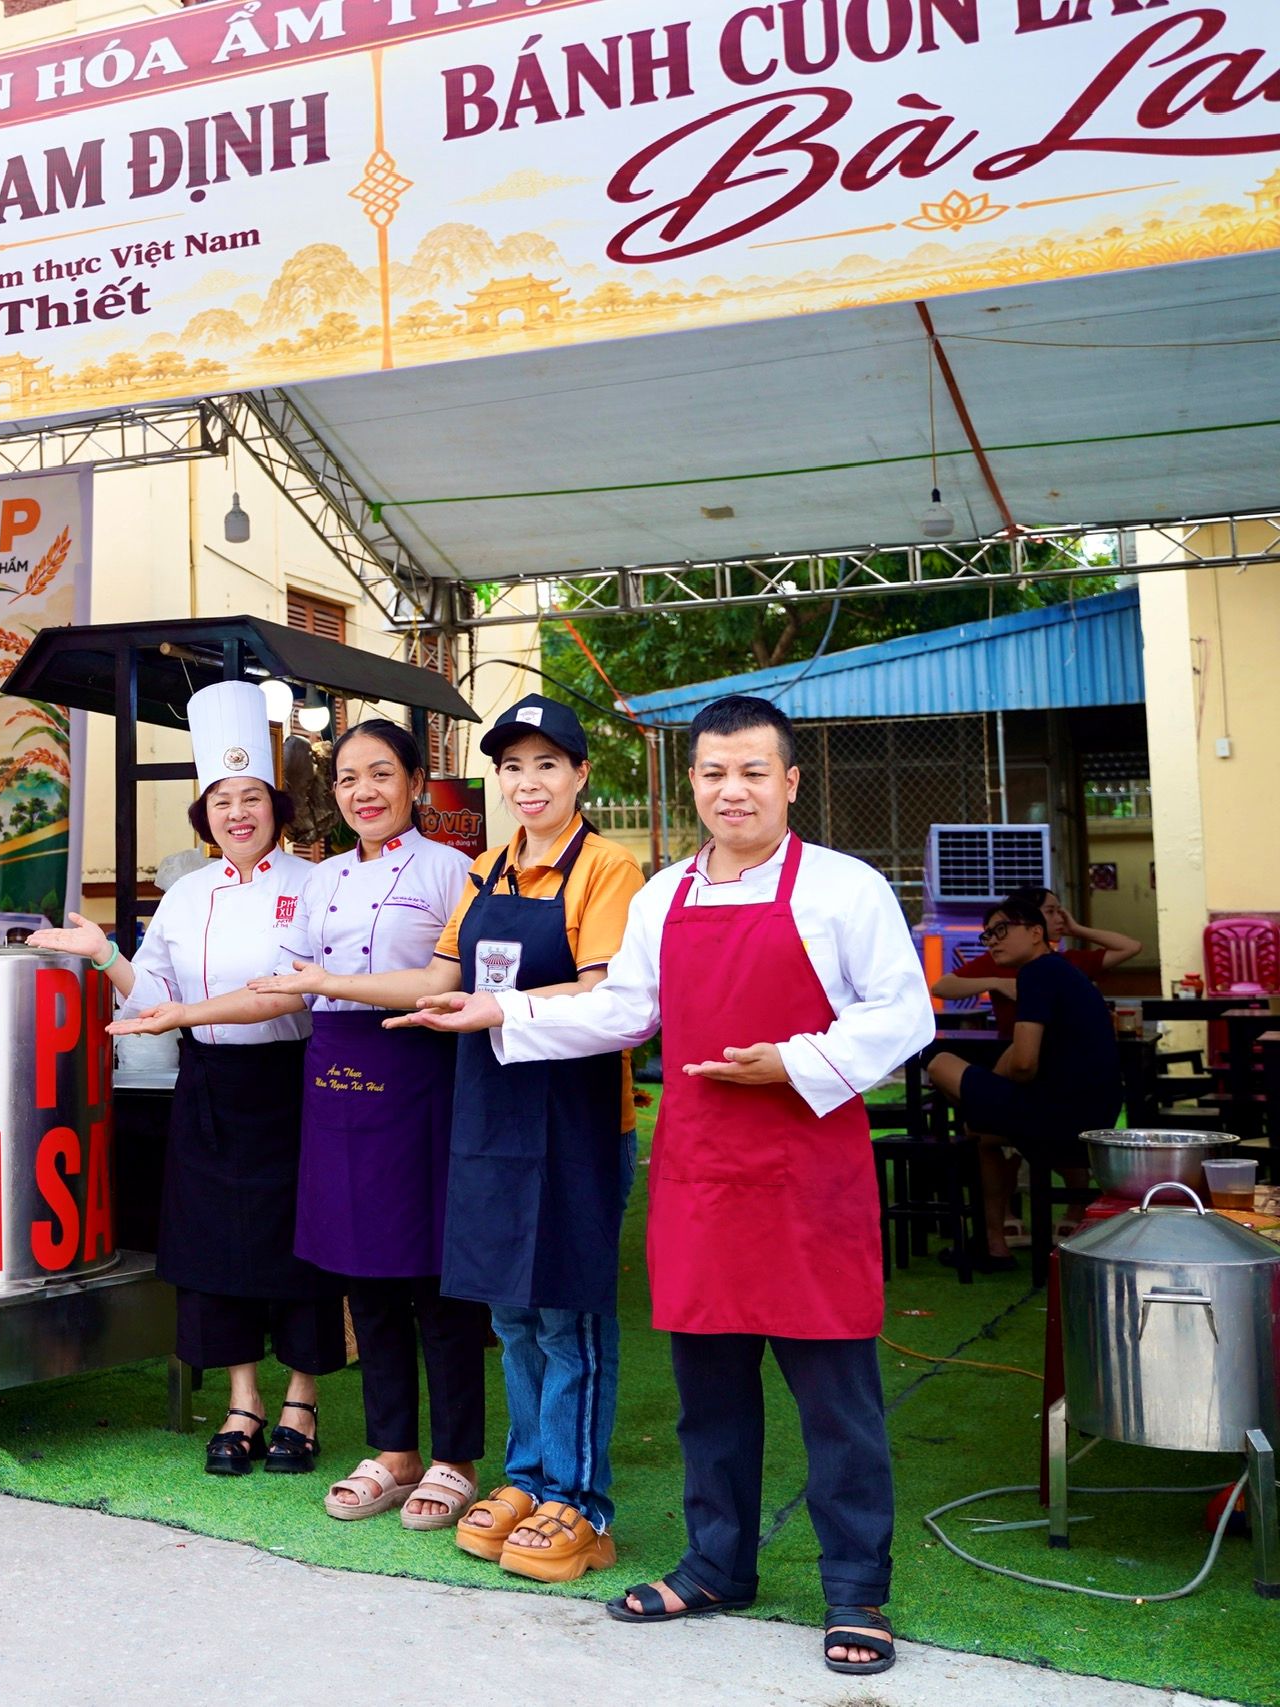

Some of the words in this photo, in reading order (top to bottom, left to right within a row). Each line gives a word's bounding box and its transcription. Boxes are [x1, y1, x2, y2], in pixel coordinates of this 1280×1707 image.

[35, 37, 188, 102] HÓA
[211, 0, 346, 64] ẨM
[440, 20, 695, 141] BÁNH
[127, 91, 330, 203] ĐỊNH
[606, 86, 980, 264] Bà
[973, 8, 1280, 181] La
[32, 254, 101, 284] thực
[110, 239, 176, 269] Việt
[185, 227, 261, 255] Nam
[441, 810, 482, 837] VIỆT
[35, 969, 113, 1109] PH
